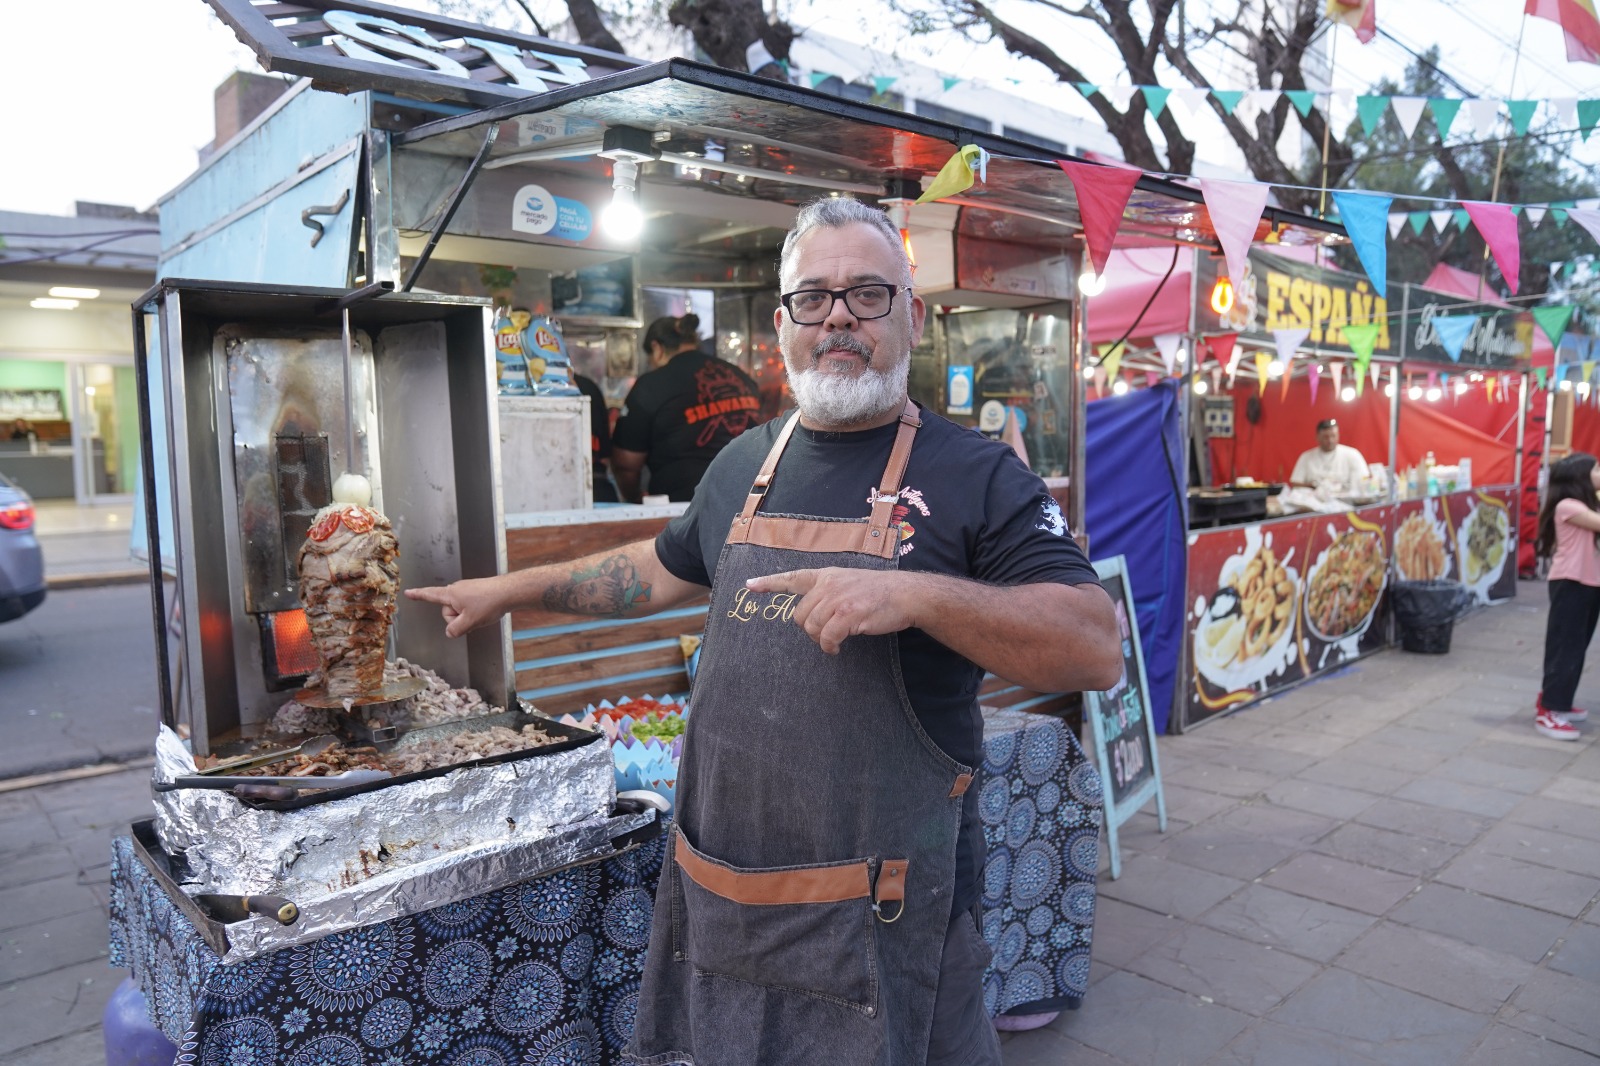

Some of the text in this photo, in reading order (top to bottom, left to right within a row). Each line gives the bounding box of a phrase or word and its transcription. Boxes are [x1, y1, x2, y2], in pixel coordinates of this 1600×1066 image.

[520, 210, 548, 220] mercado
[526, 217, 542, 225] pago
[1265, 271, 1391, 350] ESPAÑA
[899, 485, 931, 516] Antiguos
[727, 587, 759, 622] Los
